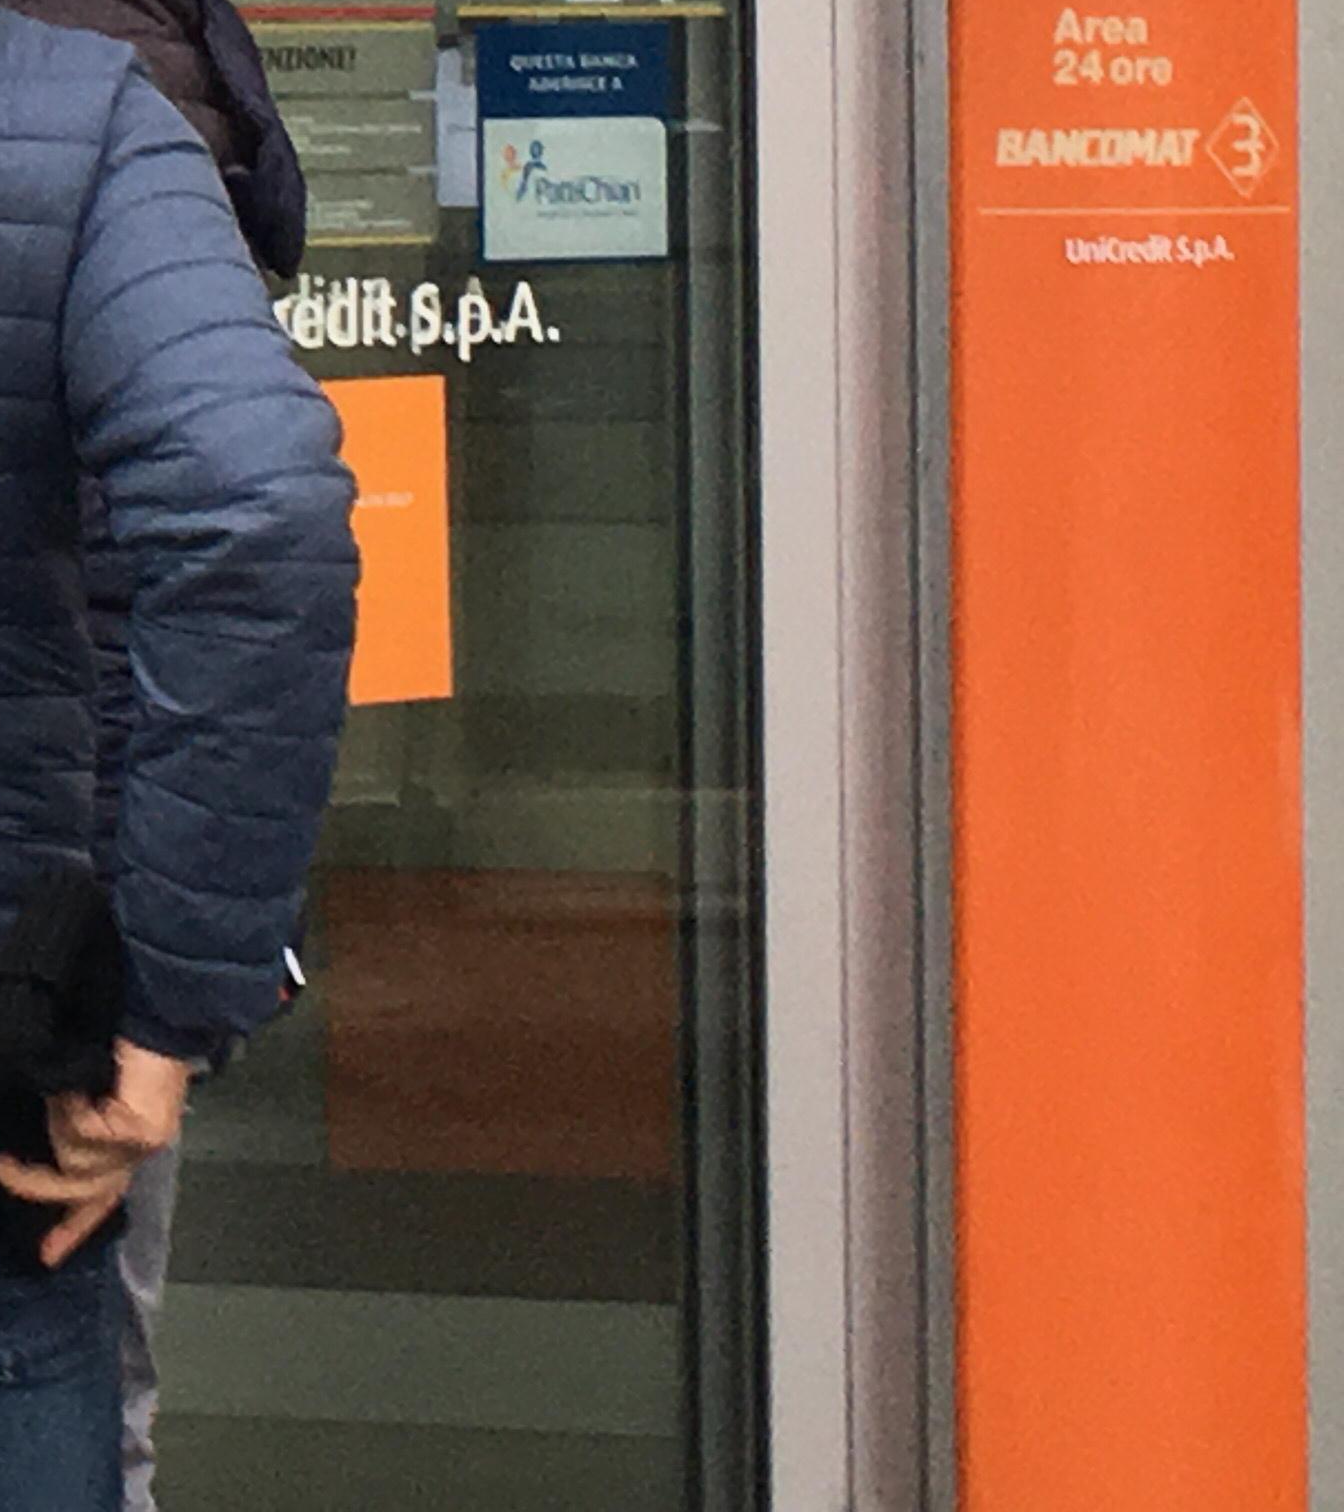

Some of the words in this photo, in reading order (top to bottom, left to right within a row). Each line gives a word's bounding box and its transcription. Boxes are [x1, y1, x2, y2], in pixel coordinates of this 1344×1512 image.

[1054, 8, 1149, 45] Area
[1053, 49, 1105, 86] 24
[1109, 56, 1172, 86] ore
[996, 128, 1200, 167] BANCOMAT
[1065, 235, 1172, 264] UniCredit
